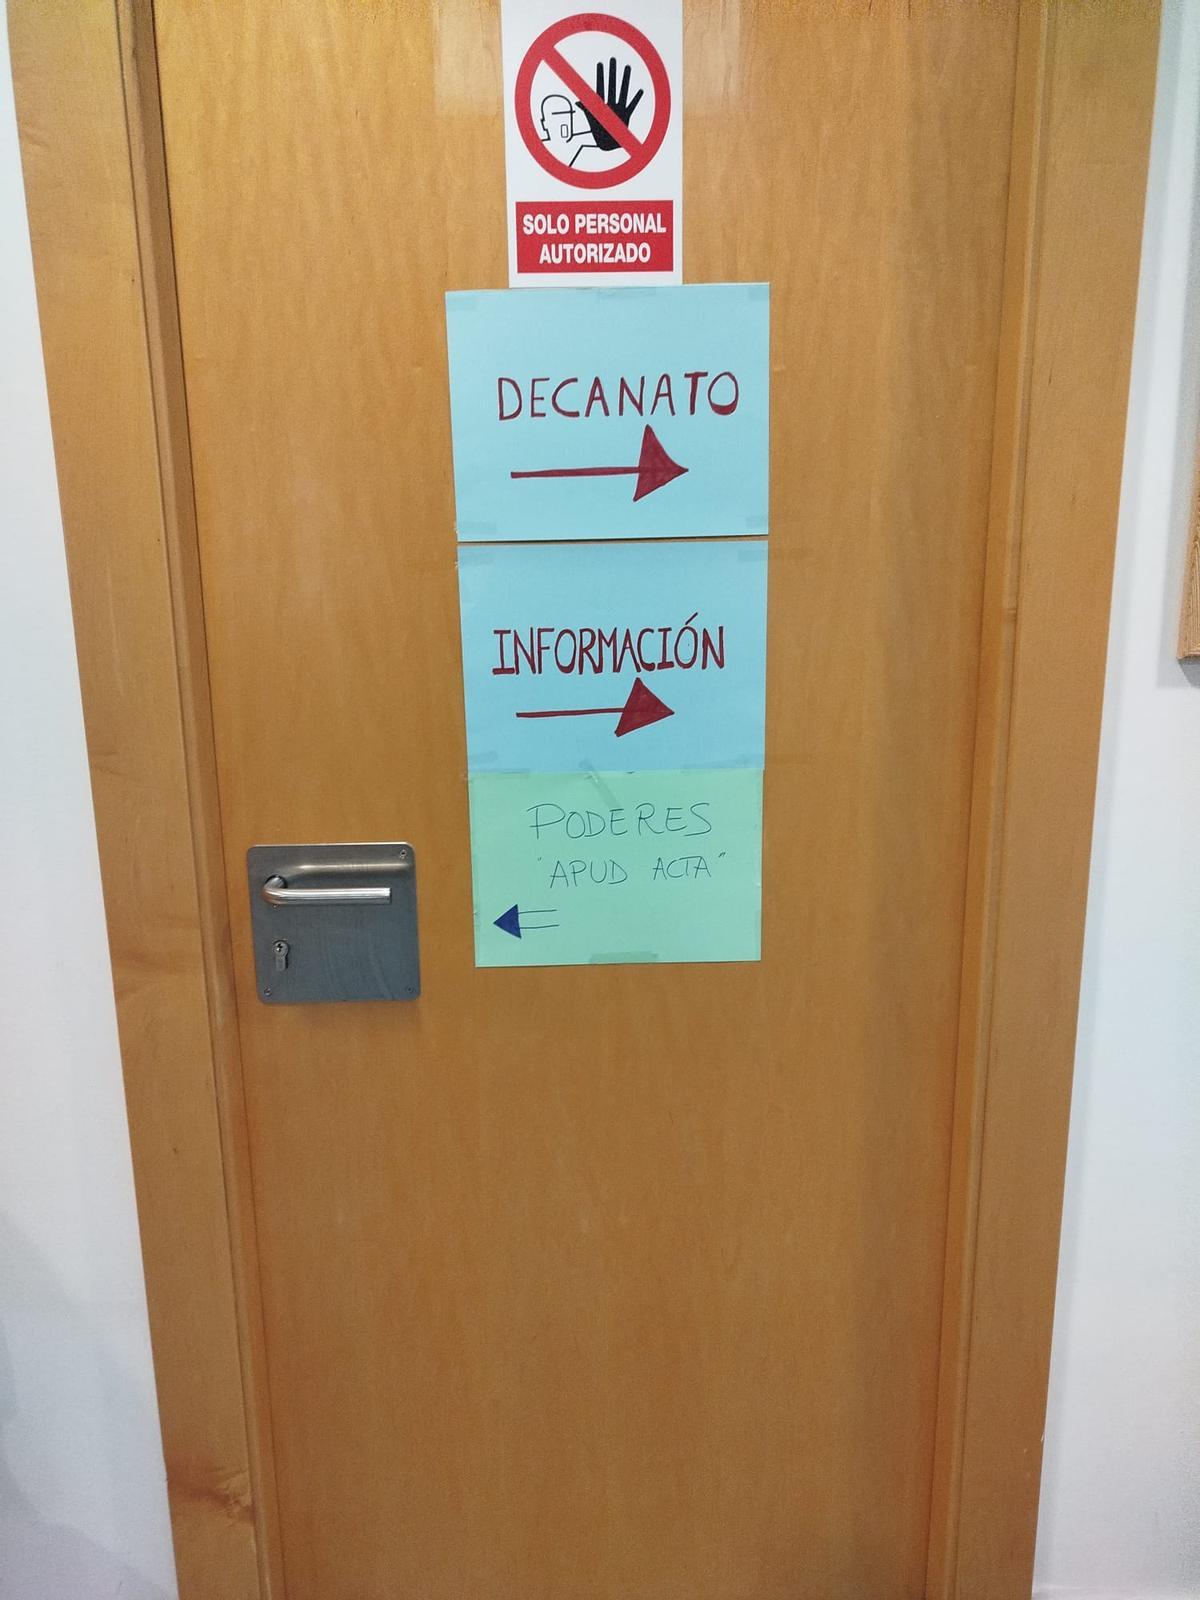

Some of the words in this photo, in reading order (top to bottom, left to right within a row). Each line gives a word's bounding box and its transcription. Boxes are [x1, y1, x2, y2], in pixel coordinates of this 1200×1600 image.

[523, 213, 570, 235] SOLO
[575, 213, 667, 234] PERSONAL
[539, 242, 651, 264] AUTORIZADO
[498, 372, 739, 420] DECANATO
[492, 612, 724, 675] INFORMACIÓN
[527, 802, 712, 839] PODERES
